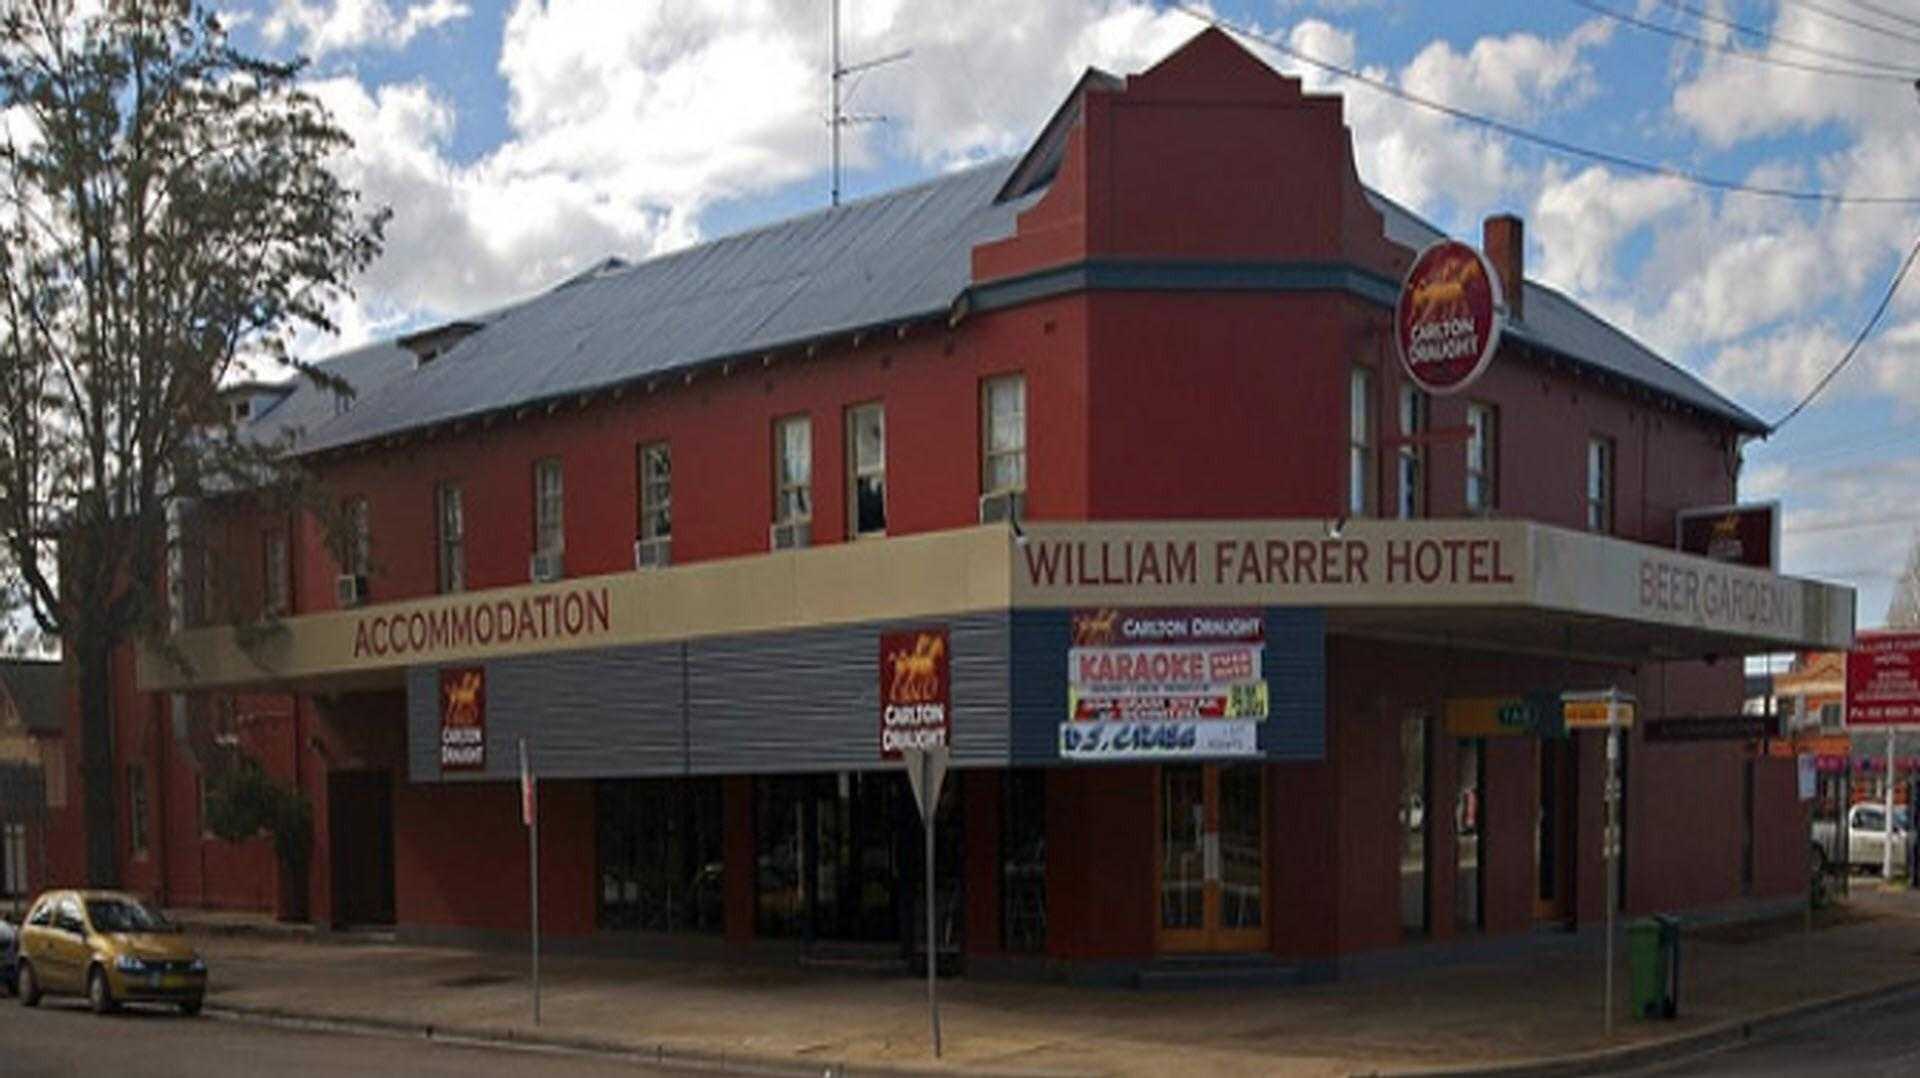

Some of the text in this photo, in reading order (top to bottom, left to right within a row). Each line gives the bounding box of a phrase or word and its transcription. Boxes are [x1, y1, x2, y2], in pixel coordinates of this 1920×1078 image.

[1025, 540, 1515, 585] WILLIAM FARRER HOTEL
[1639, 560, 1698, 613] BEER
[354, 587, 609, 659] ACCOMMODATION
[1123, 617, 1260, 637] CARLTON DRAUGHT
[1079, 653, 1204, 683] KARAOKE
[885, 704, 945, 726] CARLTON
[883, 726, 946, 751] DRAUGHT
